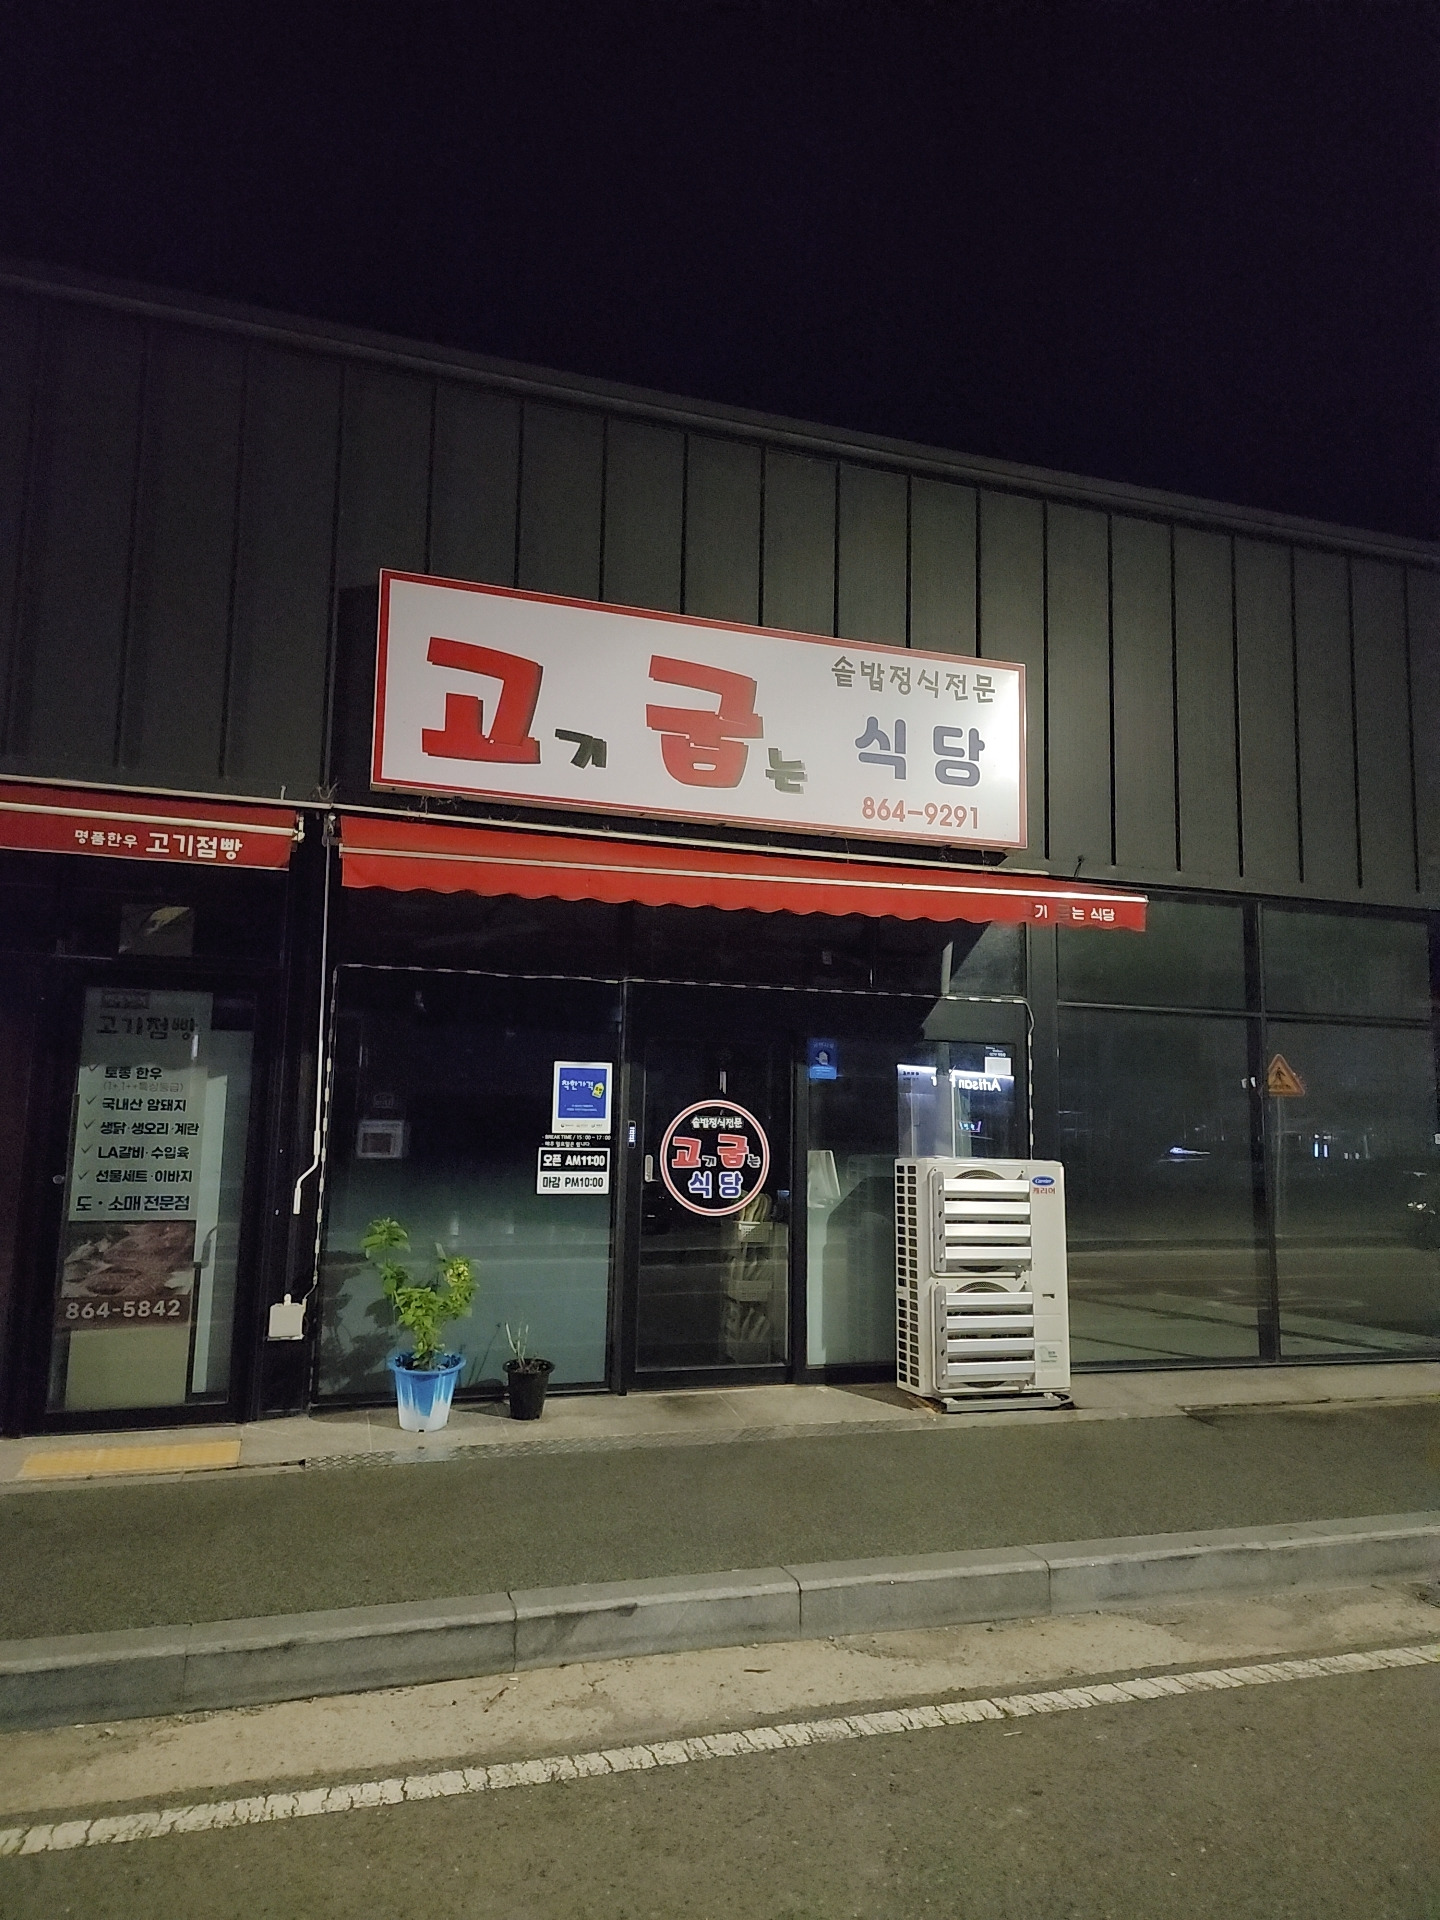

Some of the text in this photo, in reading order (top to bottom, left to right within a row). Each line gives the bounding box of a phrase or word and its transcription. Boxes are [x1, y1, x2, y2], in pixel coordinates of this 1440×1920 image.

[831, 655, 996, 705] 솥밥정식전문
[862, 797, 980, 831] 864-9291
[74, 829, 243, 860] 명품한우 고기점빵
[1090, 907, 1115, 922] 식당
[96, 1015, 197, 1040] 고기점빵
[104, 1066, 162, 1080] 토종 한우
[102, 1097, 187, 1112] 국내산 암돼지
[542, 1153, 561, 1167] 오픈
[542, 1176, 604, 1188] 마감 PM10:00
[1032, 1187, 1056, 1195] 캐리어
[144, 1195, 191, 1212] 전문점
[65, 1299, 181, 1320] 864-5842
